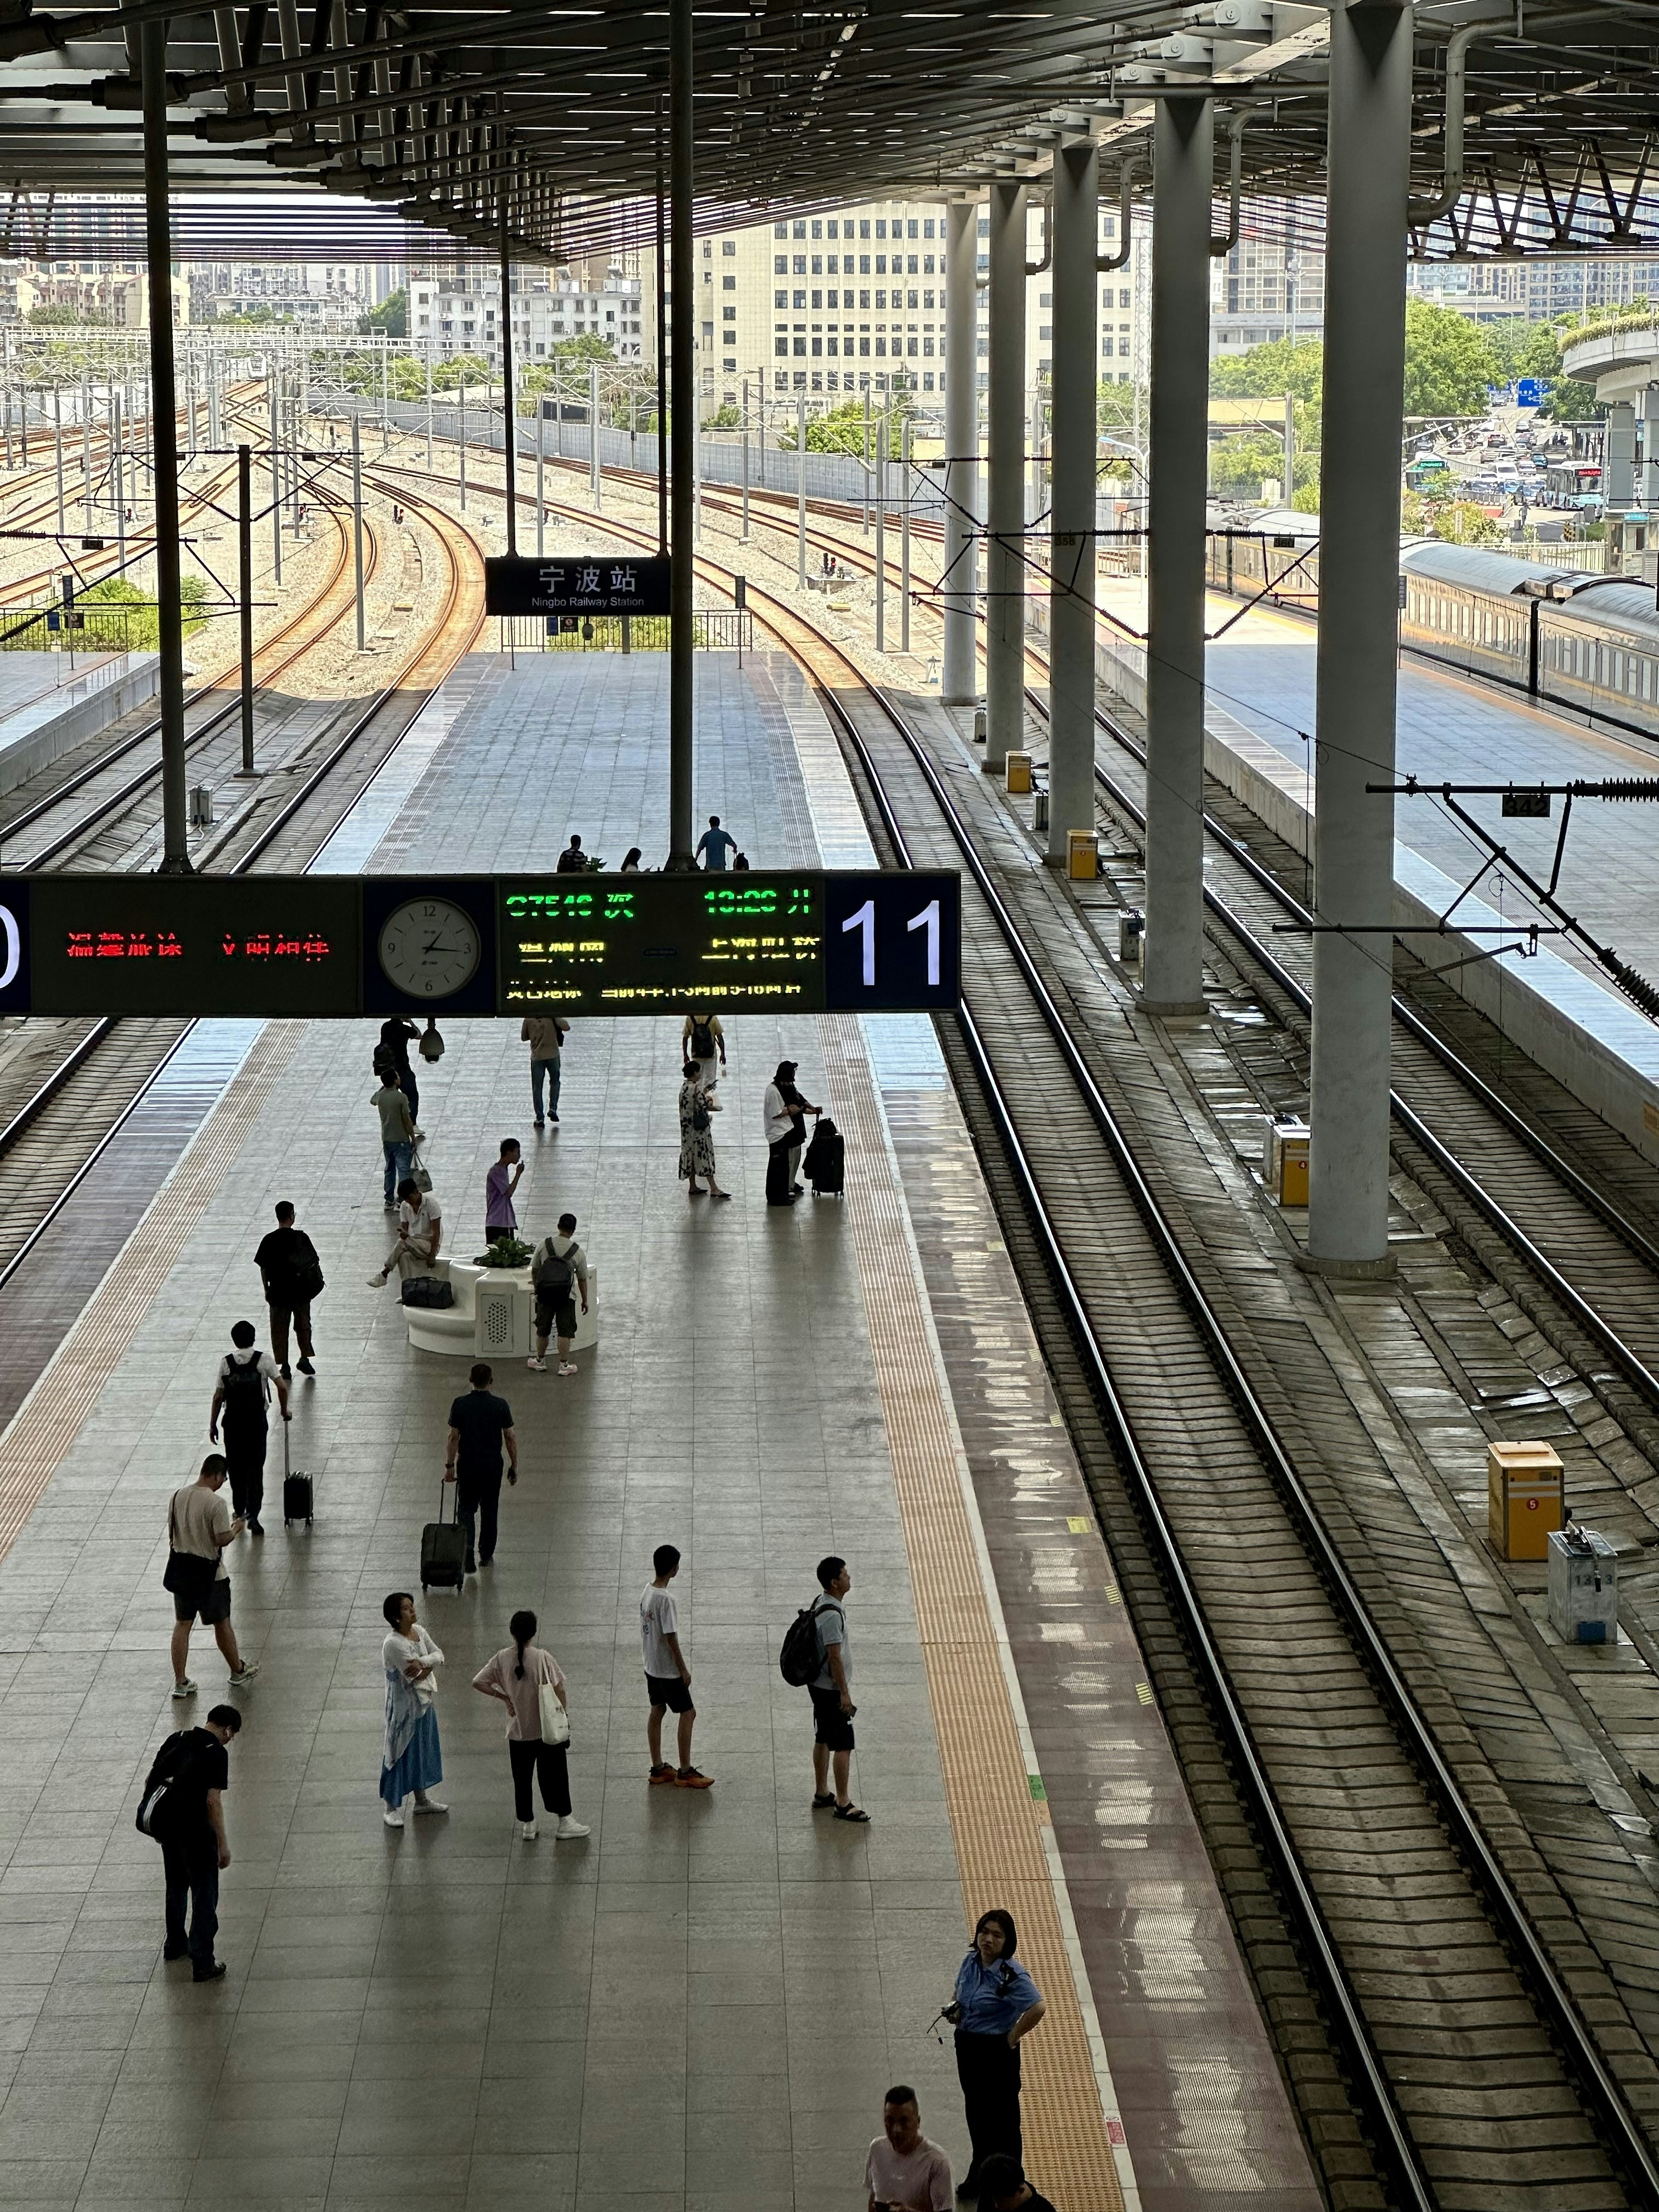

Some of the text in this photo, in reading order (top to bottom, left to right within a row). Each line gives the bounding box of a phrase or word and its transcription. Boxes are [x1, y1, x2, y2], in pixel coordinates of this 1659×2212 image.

[539, 565, 637, 594] 宁波站
[532, 596, 645, 608] Ningbo Railway Station
[1504, 799, 1548, 815] 342
[423, 905, 436, 917] 12
[388, 943, 396, 954] 9
[463, 943, 471, 954] 3
[842, 900, 940, 986] 11
[425, 980, 433, 992] 6
[1530, 1500, 1536, 1509] 5
